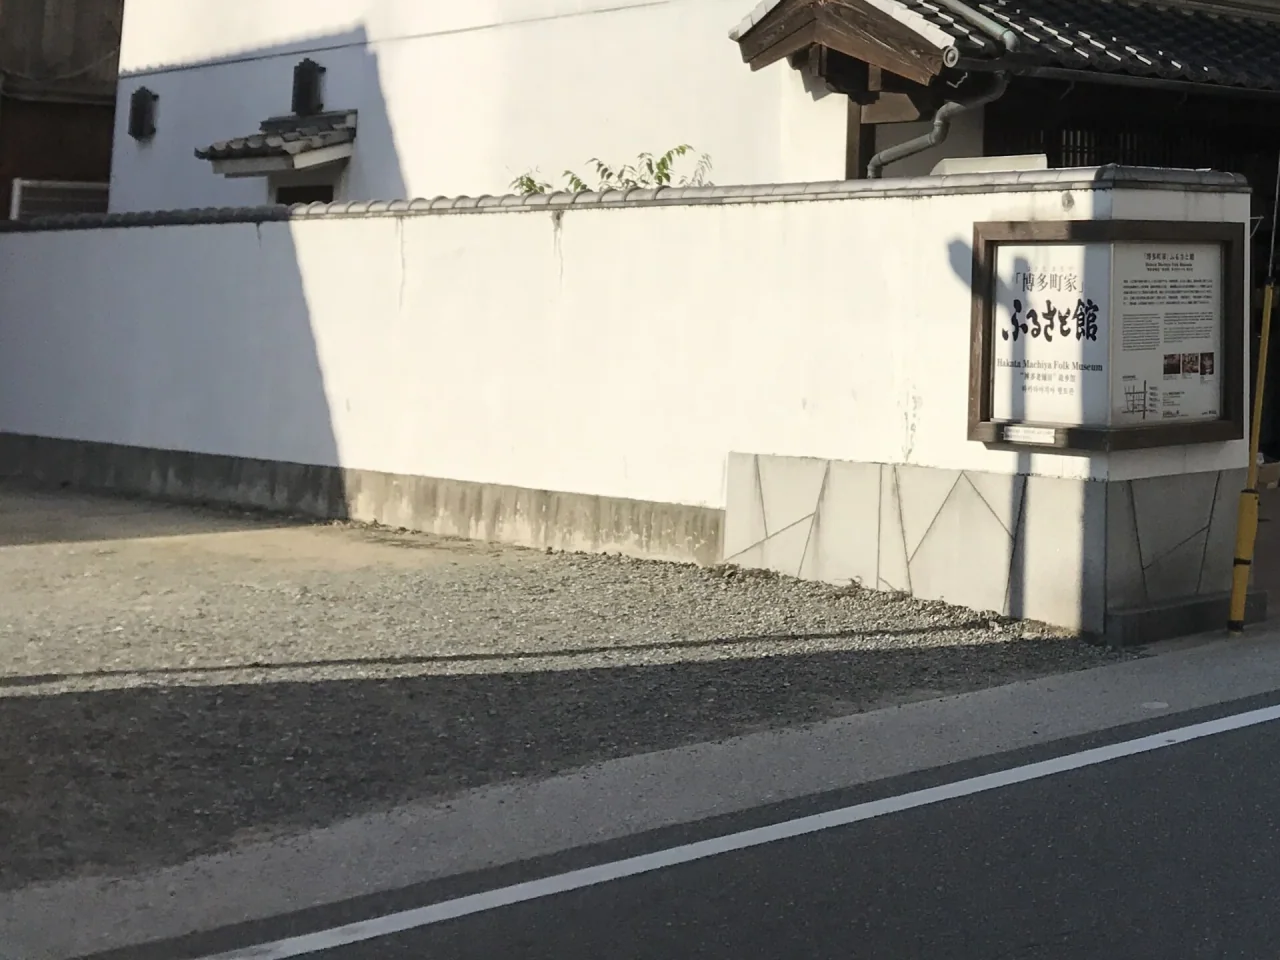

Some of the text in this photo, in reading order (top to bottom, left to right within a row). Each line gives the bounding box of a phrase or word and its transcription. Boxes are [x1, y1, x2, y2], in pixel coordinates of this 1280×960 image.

[1002, 298, 1099, 343] ふるさと館
[997, 358, 1103, 371] Hakata Machiya Folk Museum
